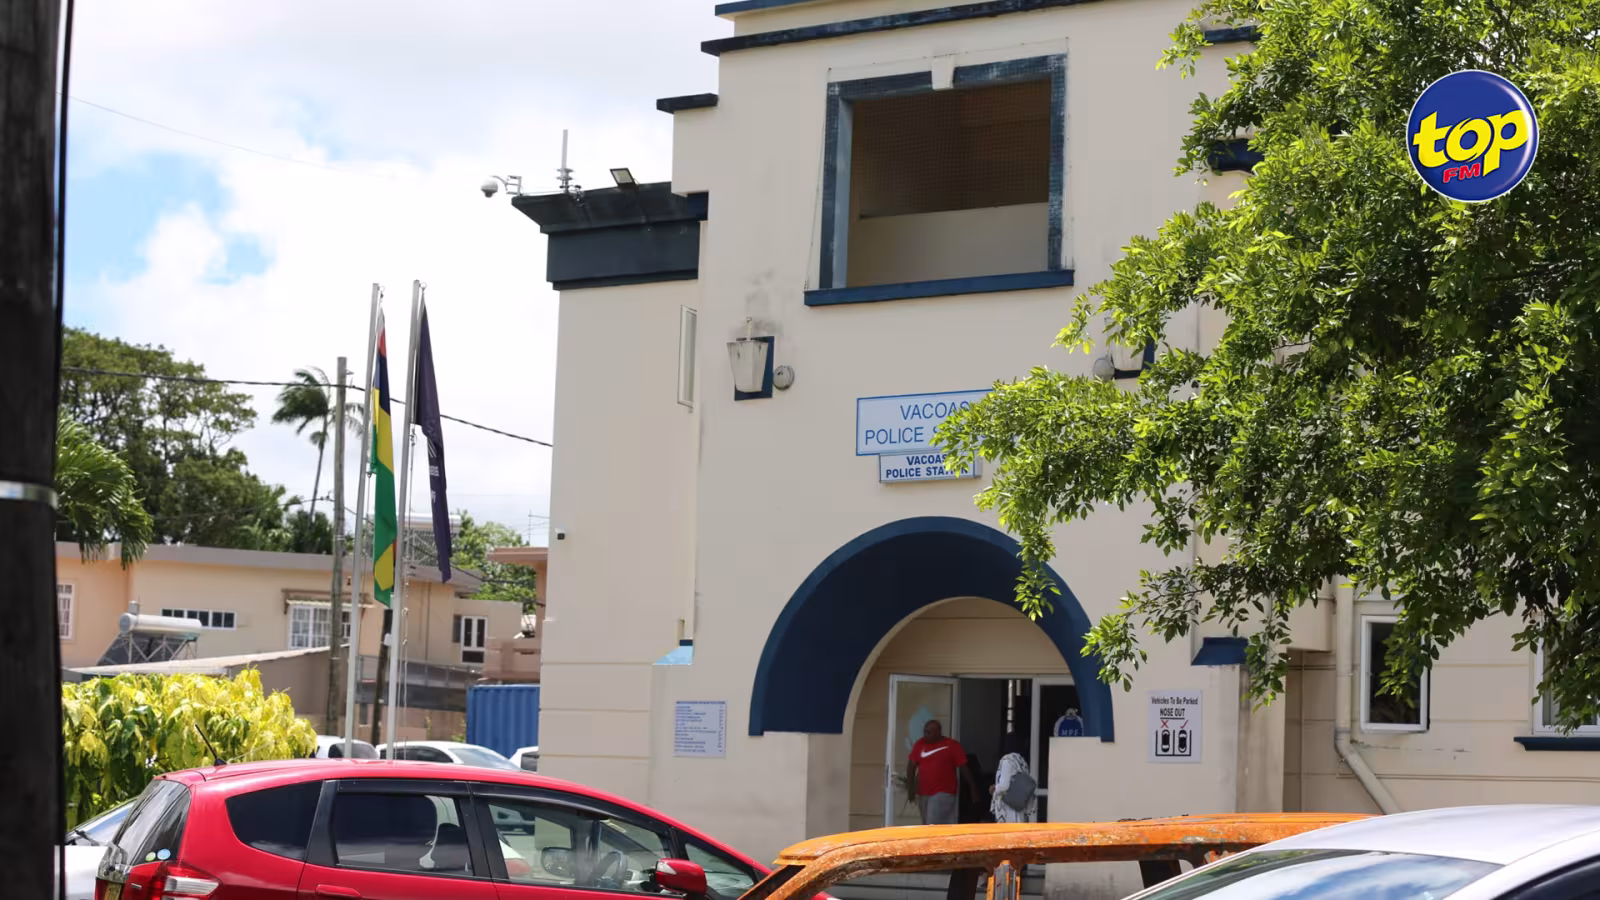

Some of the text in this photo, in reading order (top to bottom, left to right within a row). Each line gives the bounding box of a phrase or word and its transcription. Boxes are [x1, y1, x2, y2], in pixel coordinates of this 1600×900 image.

[865, 426, 924, 445] POLICE
[886, 467, 921, 478] POLICE
[1151, 697, 1169, 705] Vehicles
[1183, 697, 1198, 705] Parked
[1160, 708, 1185, 716] NOSE OUT
